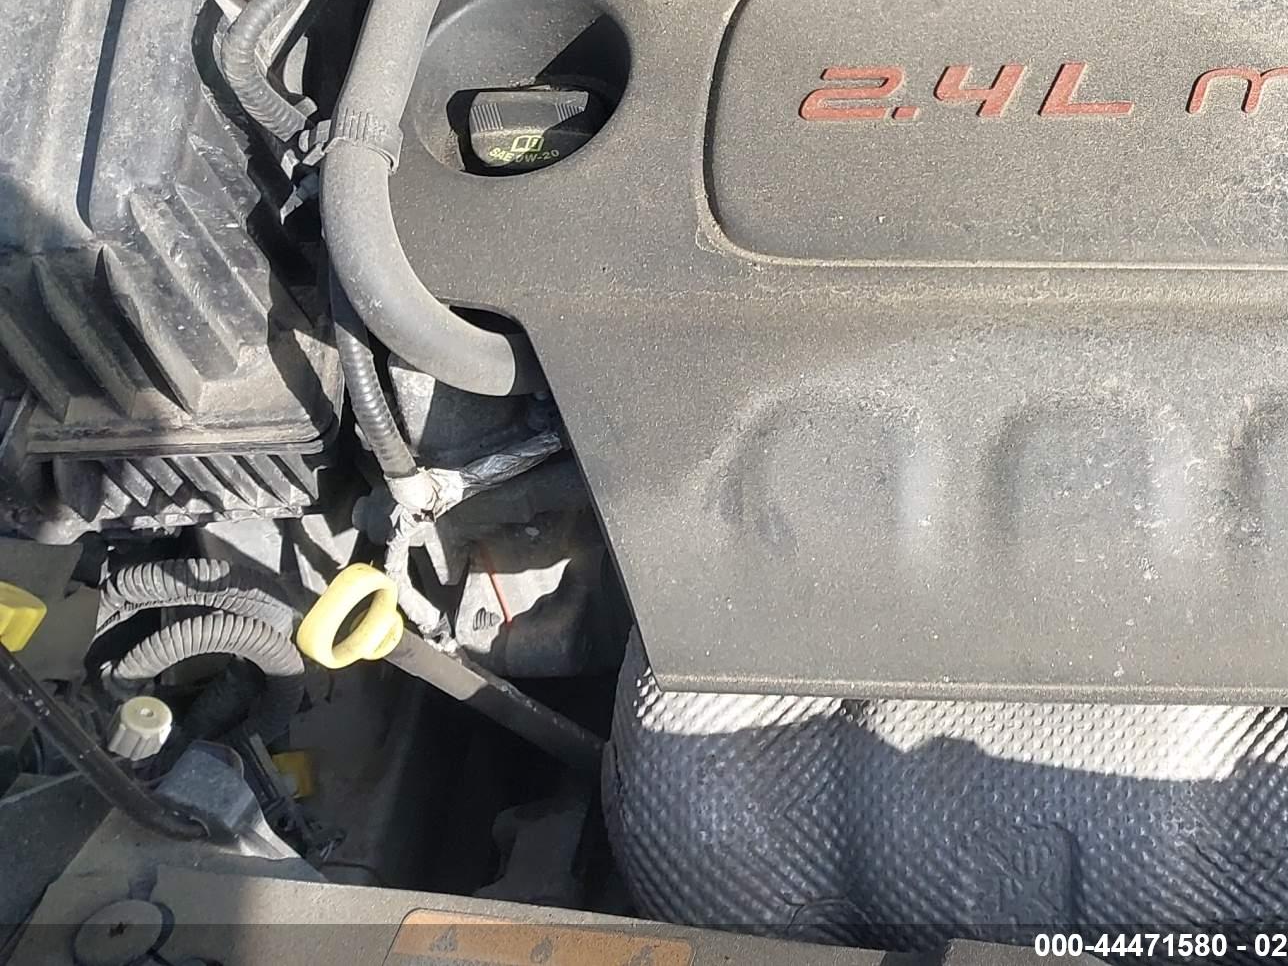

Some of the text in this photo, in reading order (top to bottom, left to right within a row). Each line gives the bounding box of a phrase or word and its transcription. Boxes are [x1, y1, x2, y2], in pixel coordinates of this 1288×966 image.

[799, 62, 1135, 121] 2.4L
[488, 147, 560, 163] SAE 0W-20
